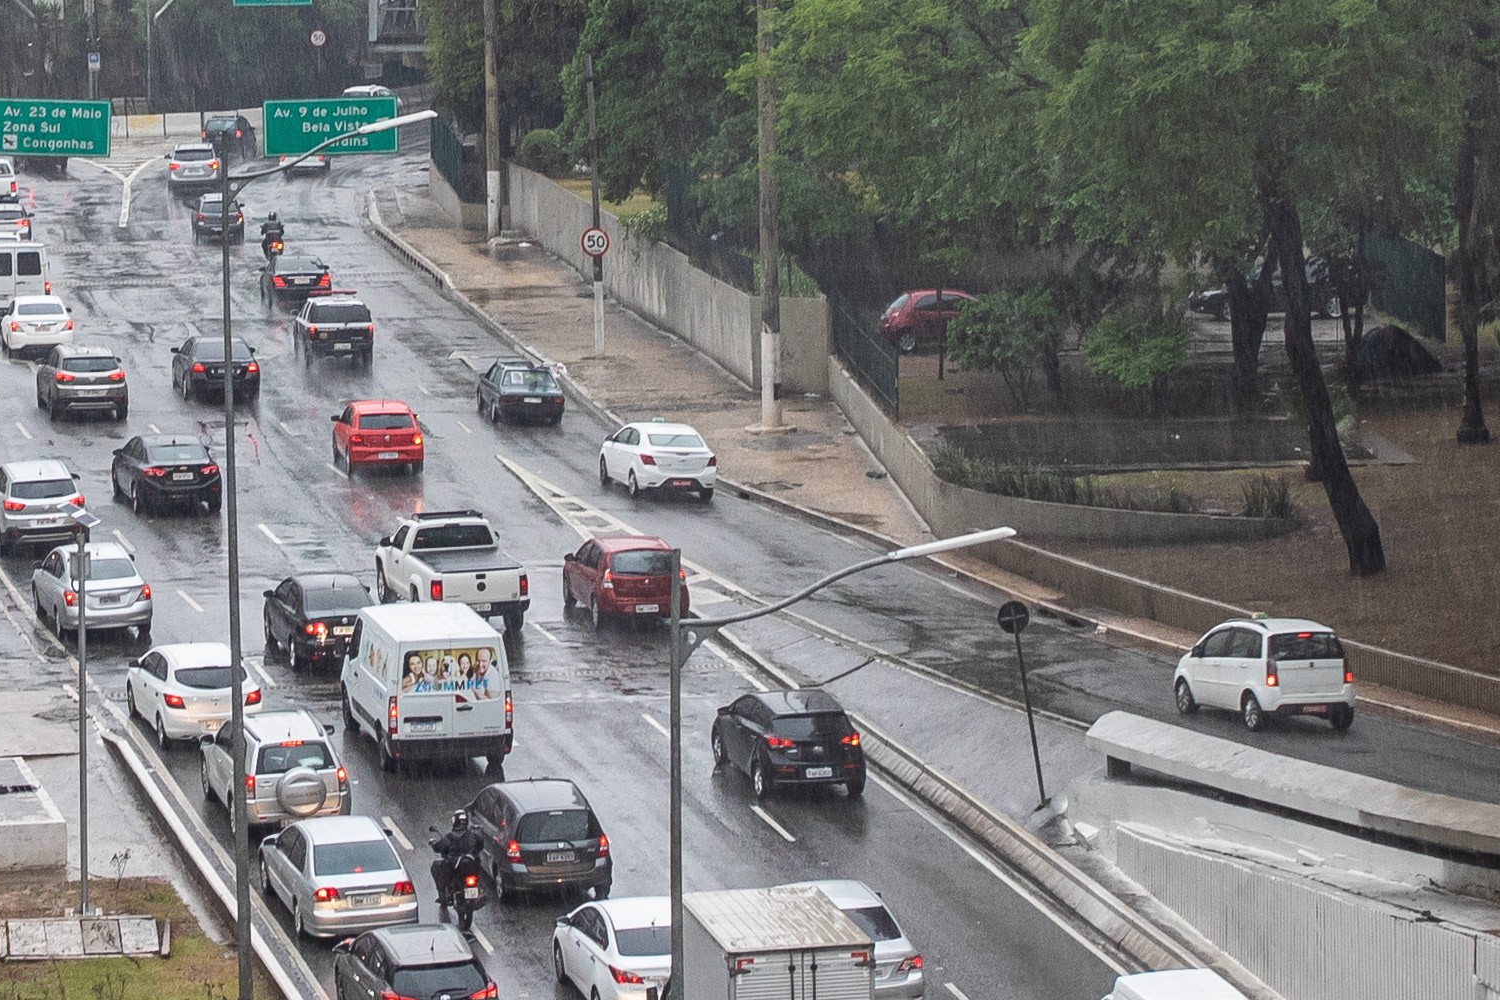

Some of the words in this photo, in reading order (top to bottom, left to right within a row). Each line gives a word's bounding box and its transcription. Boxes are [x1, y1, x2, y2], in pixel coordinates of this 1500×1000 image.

[3, 106, 23, 117] Av.
[28, 106, 47, 118] 23
[51, 107, 66, 118] de
[71, 107, 102, 119] Maio
[273, 107, 293, 118] Av.
[298, 106, 308, 117] 9
[312, 106, 327, 117] de
[332, 106, 368, 117] Julho
[3, 121, 35, 133] Zona
[40, 121, 61, 133] Sul
[302, 121, 330, 133] Bela
[23, 137, 94, 151] Congonhas
[587, 235, 605, 248] 50
